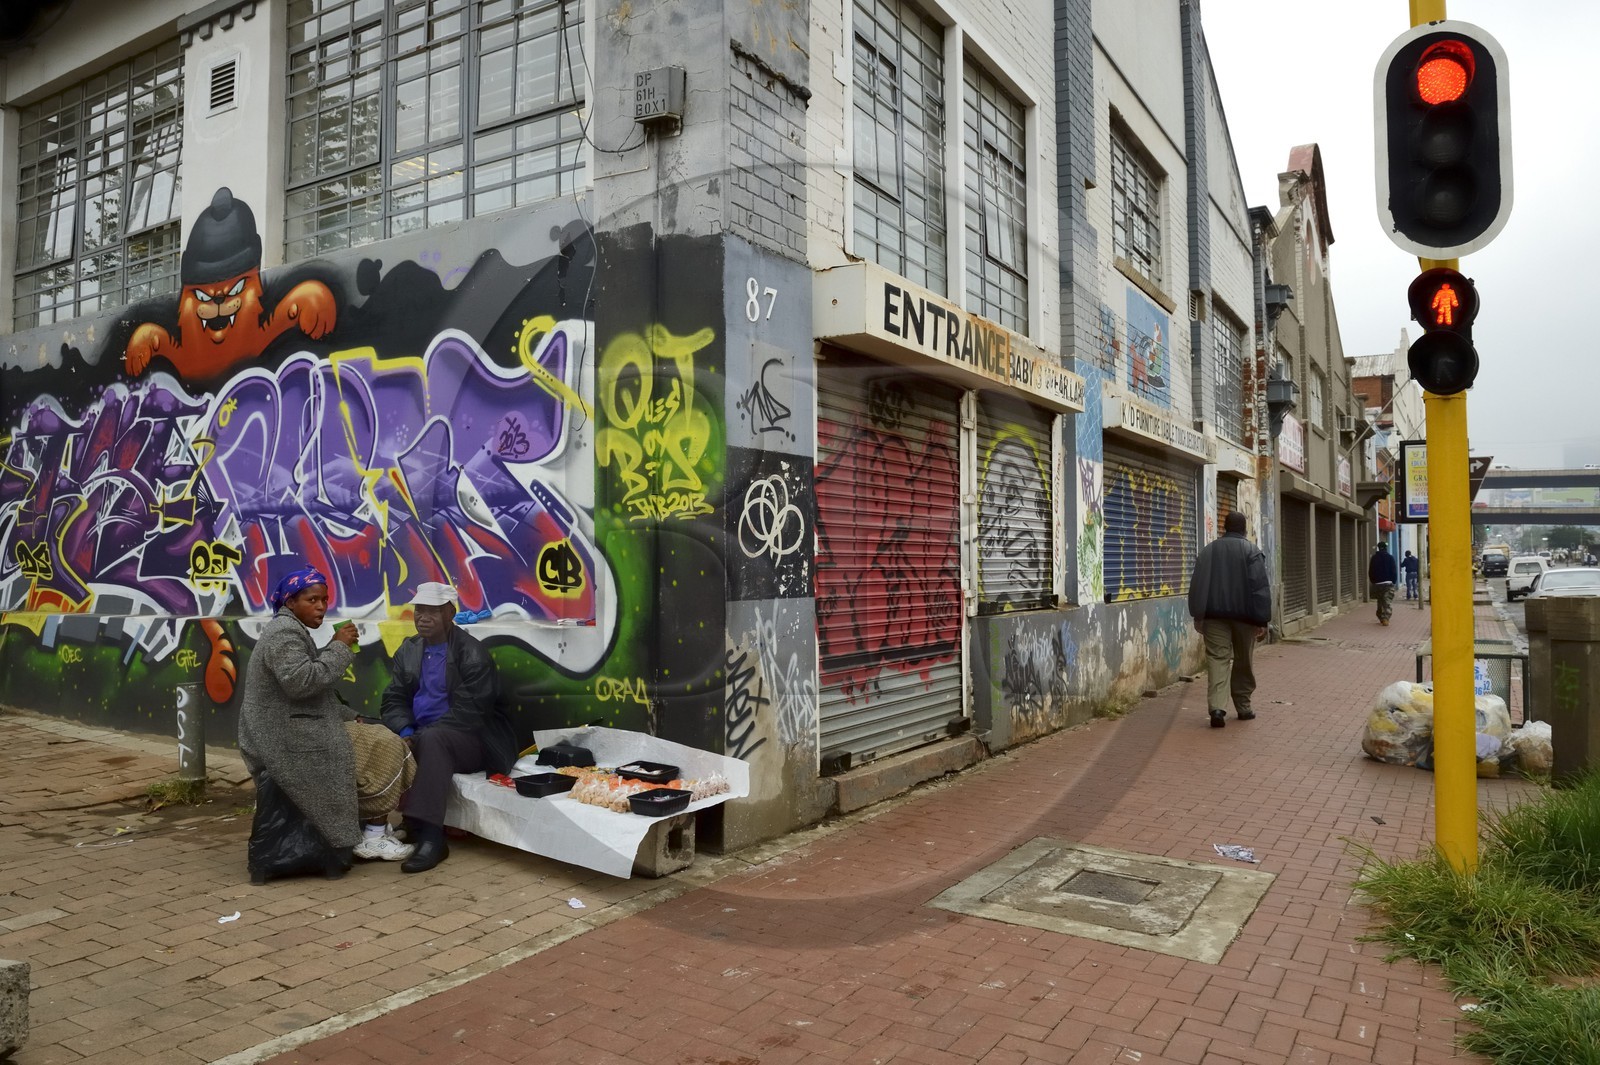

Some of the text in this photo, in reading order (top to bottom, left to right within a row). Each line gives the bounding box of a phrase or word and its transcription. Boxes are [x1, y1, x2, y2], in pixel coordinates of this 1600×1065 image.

[636, 73, 652, 88] DP
[636, 87, 655, 102] 61H
[745, 277, 778, 323] 87
[884, 282, 1007, 379] ENTRANCE
[1010, 352, 1035, 387] BABY
